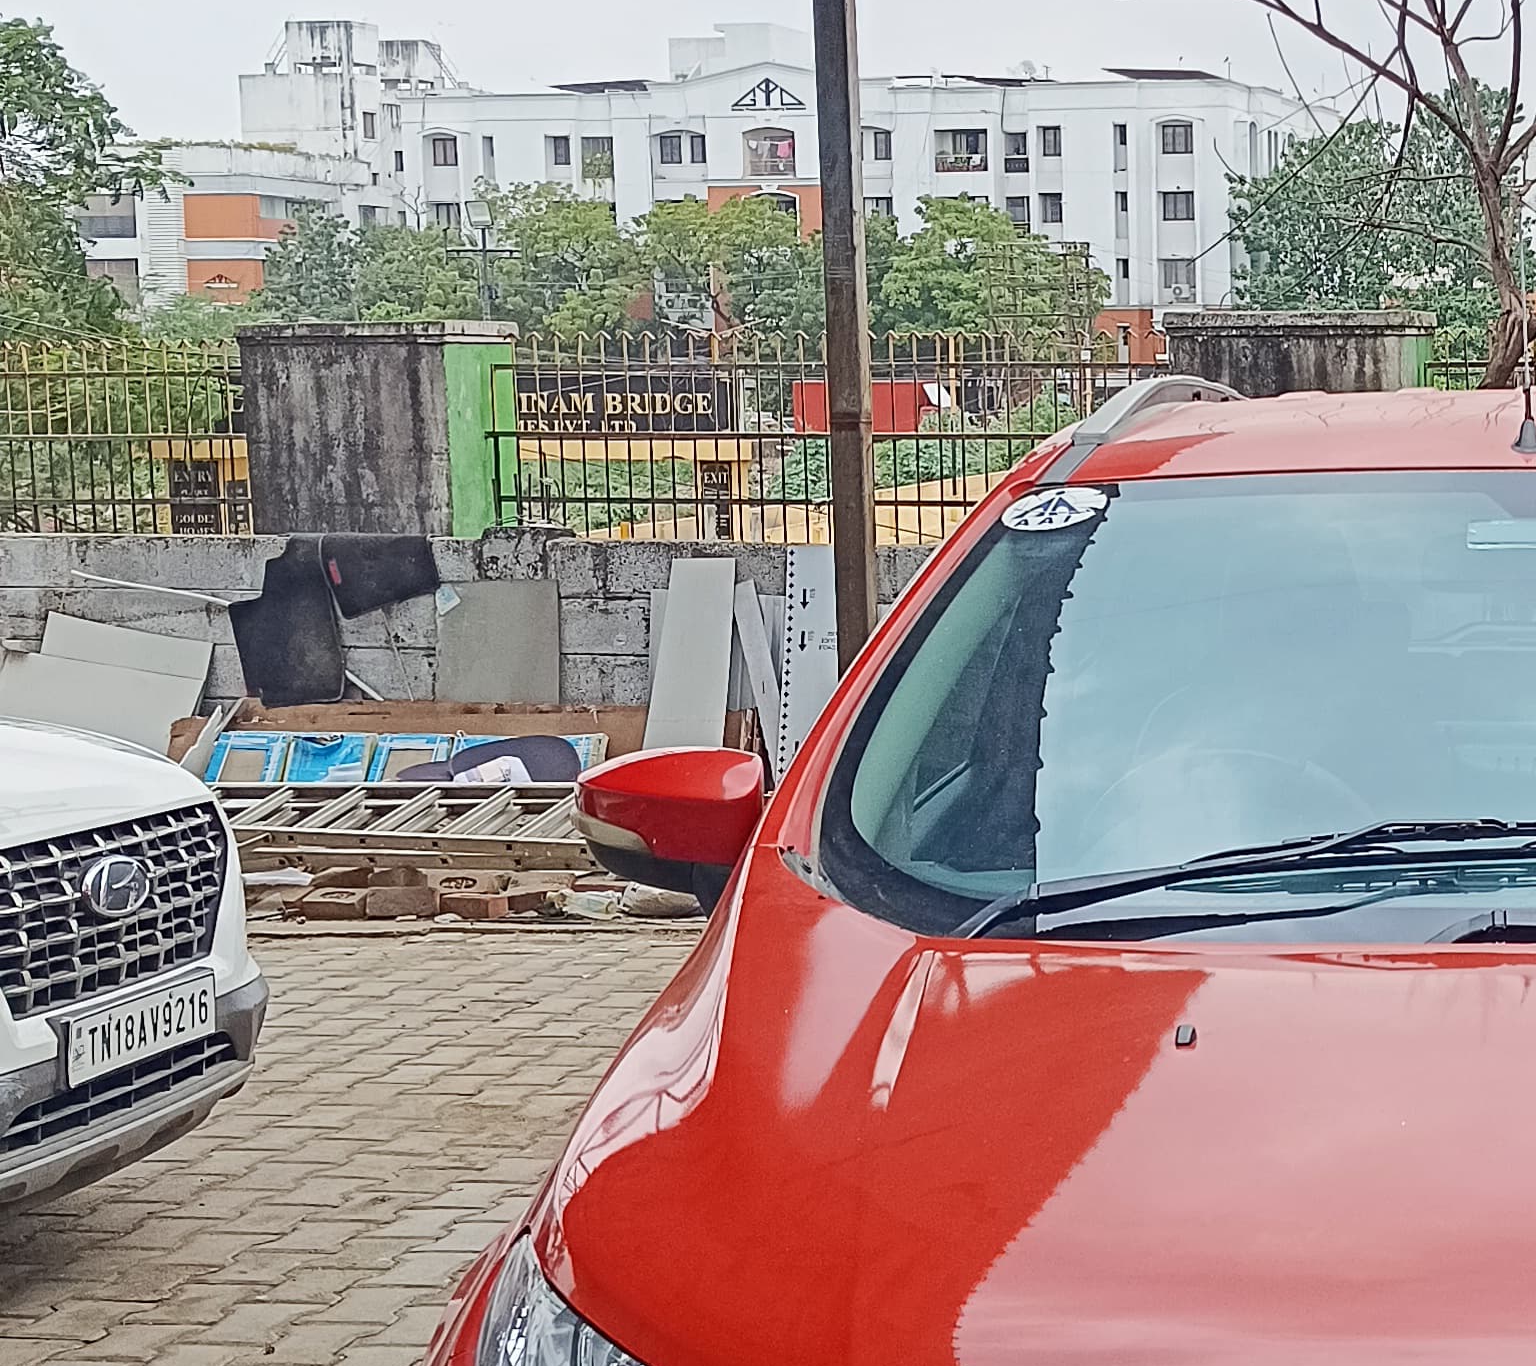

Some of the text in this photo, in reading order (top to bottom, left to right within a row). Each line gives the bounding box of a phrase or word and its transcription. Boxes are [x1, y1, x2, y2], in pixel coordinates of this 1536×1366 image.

[605, 392, 713, 415] BRIDGE
[703, 471, 728, 484] EXIT
[88, 988, 209, 1066] TN18AV9216
